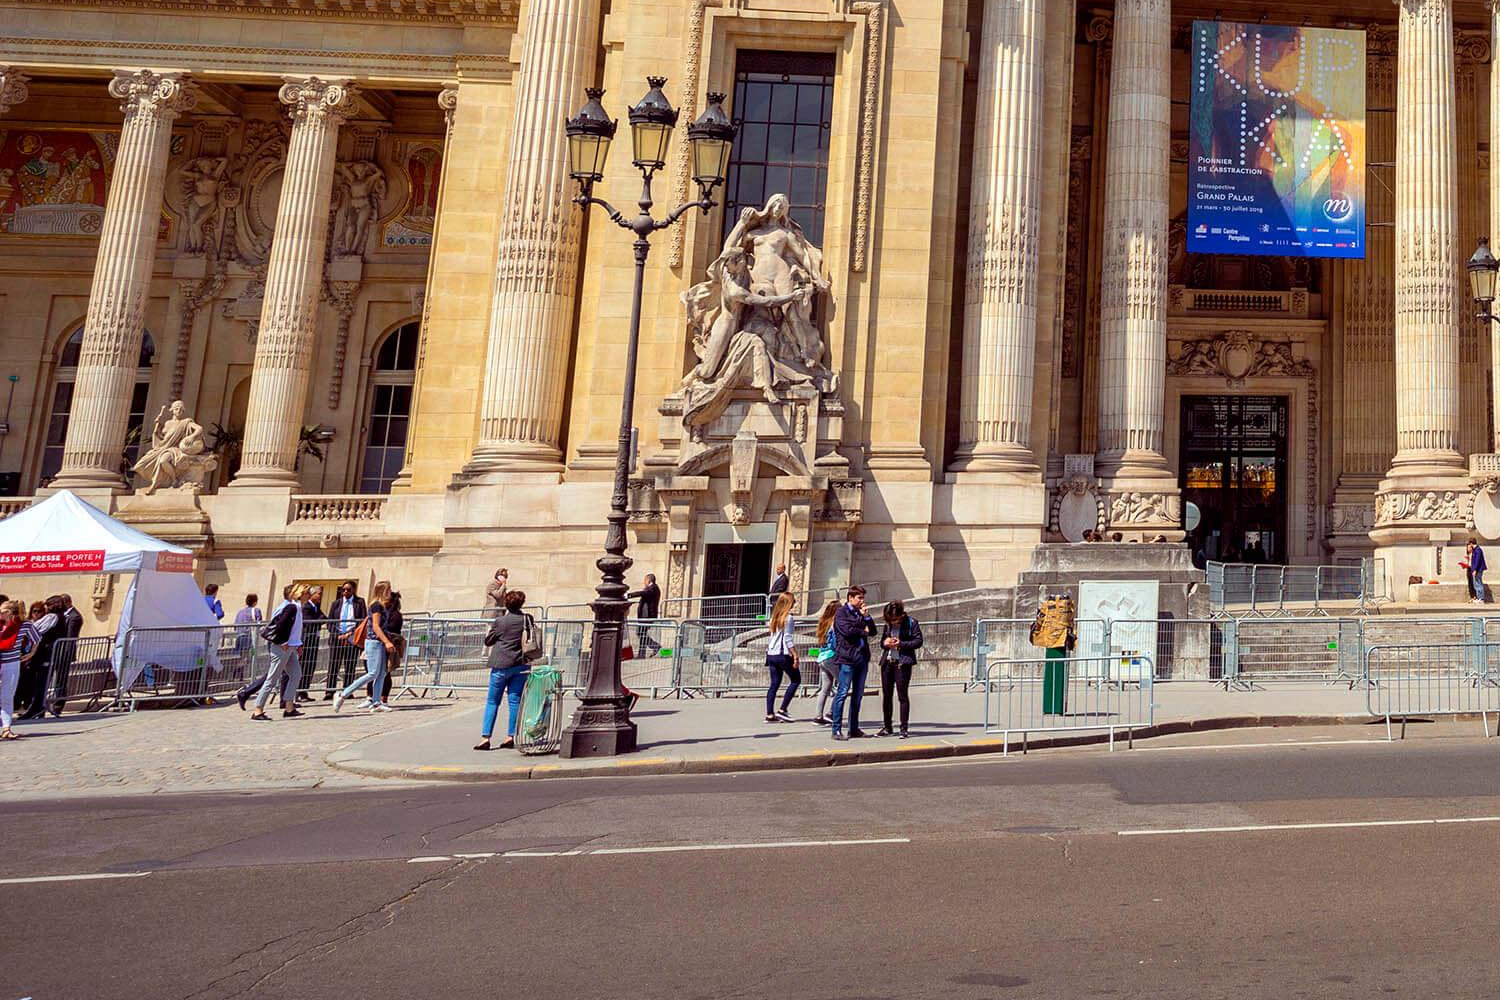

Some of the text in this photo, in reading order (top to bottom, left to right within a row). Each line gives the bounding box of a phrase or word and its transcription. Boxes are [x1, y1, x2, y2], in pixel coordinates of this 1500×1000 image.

[1197, 156, 1232, 165] PIONNIER
[1196, 191, 1255, 202] GRAND PALAIS
